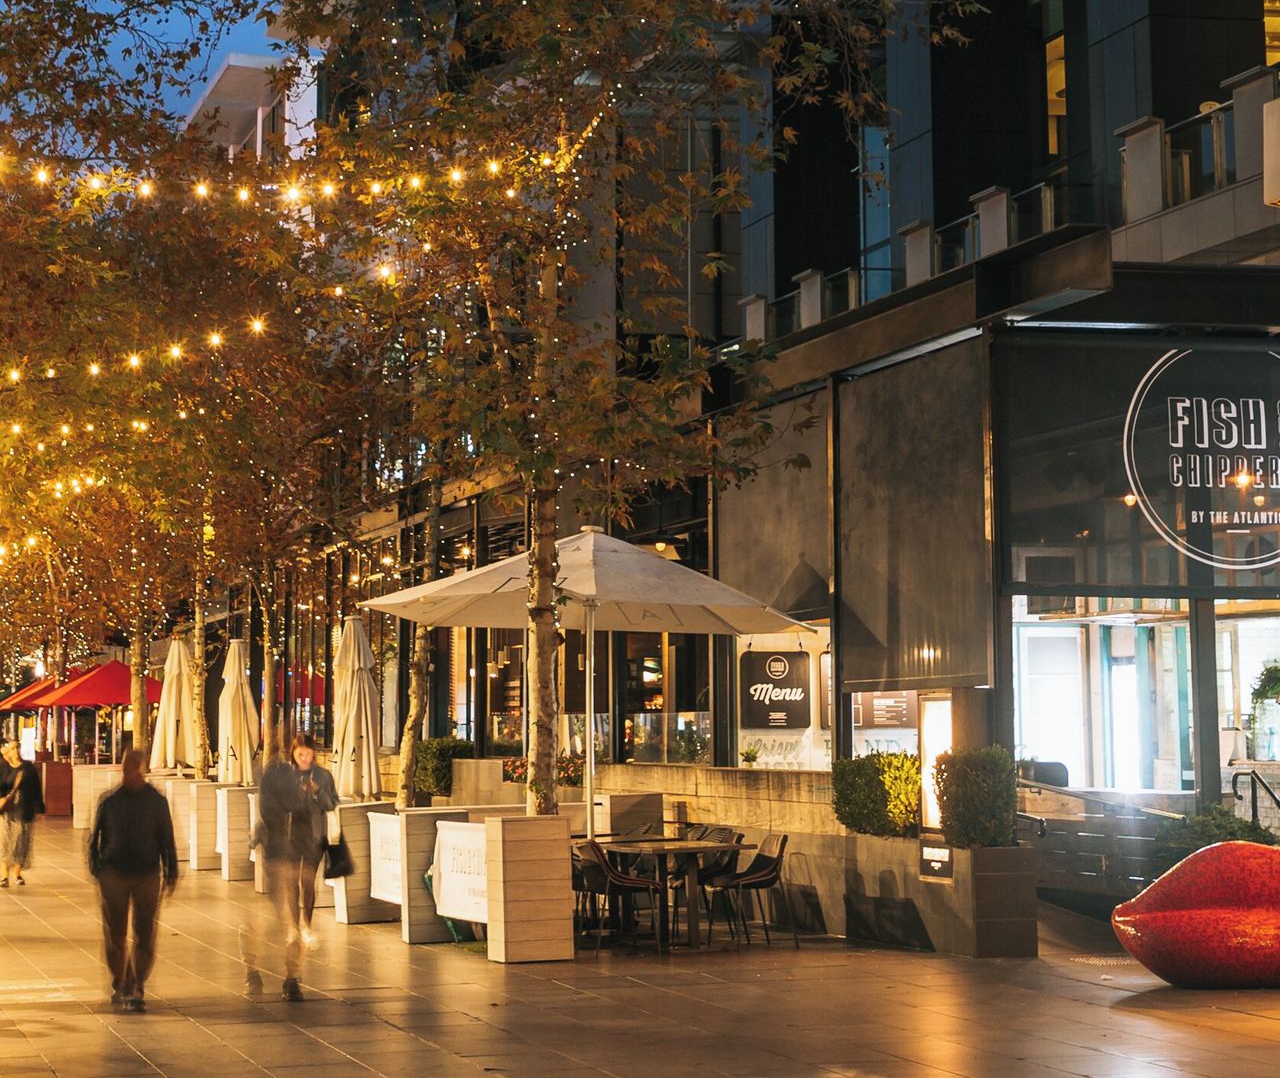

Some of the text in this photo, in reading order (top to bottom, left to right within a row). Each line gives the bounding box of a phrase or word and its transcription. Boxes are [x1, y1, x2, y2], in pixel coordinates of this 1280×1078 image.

[1167, 397, 1267, 449] FISH
[1191, 511, 1204, 523] BY
[1209, 511, 1228, 523] THE
[750, 683, 805, 705] Menu
